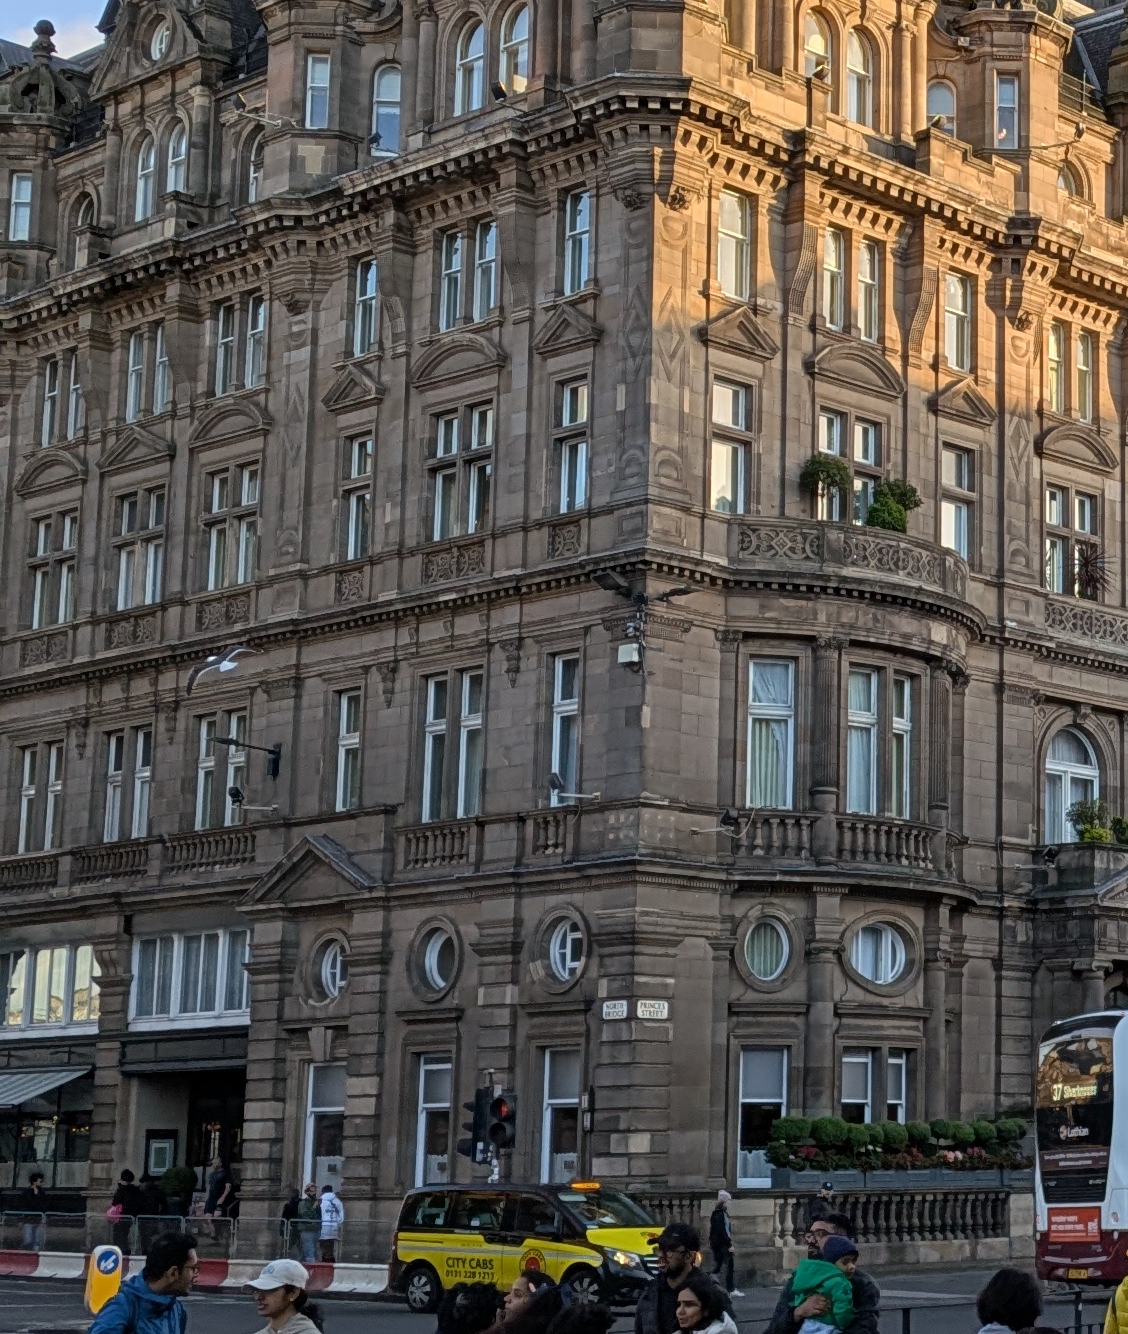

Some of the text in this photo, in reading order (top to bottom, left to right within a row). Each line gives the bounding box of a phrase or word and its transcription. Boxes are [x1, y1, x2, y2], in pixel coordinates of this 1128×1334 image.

[605, 1002, 624, 1010] NORTH
[640, 1002, 665, 1010] PRINCES
[605, 1010, 625, 1018] BRIDGE
[1052, 1083, 1063, 1101] 37
[446, 1257, 494, 1270] CITY CABS
